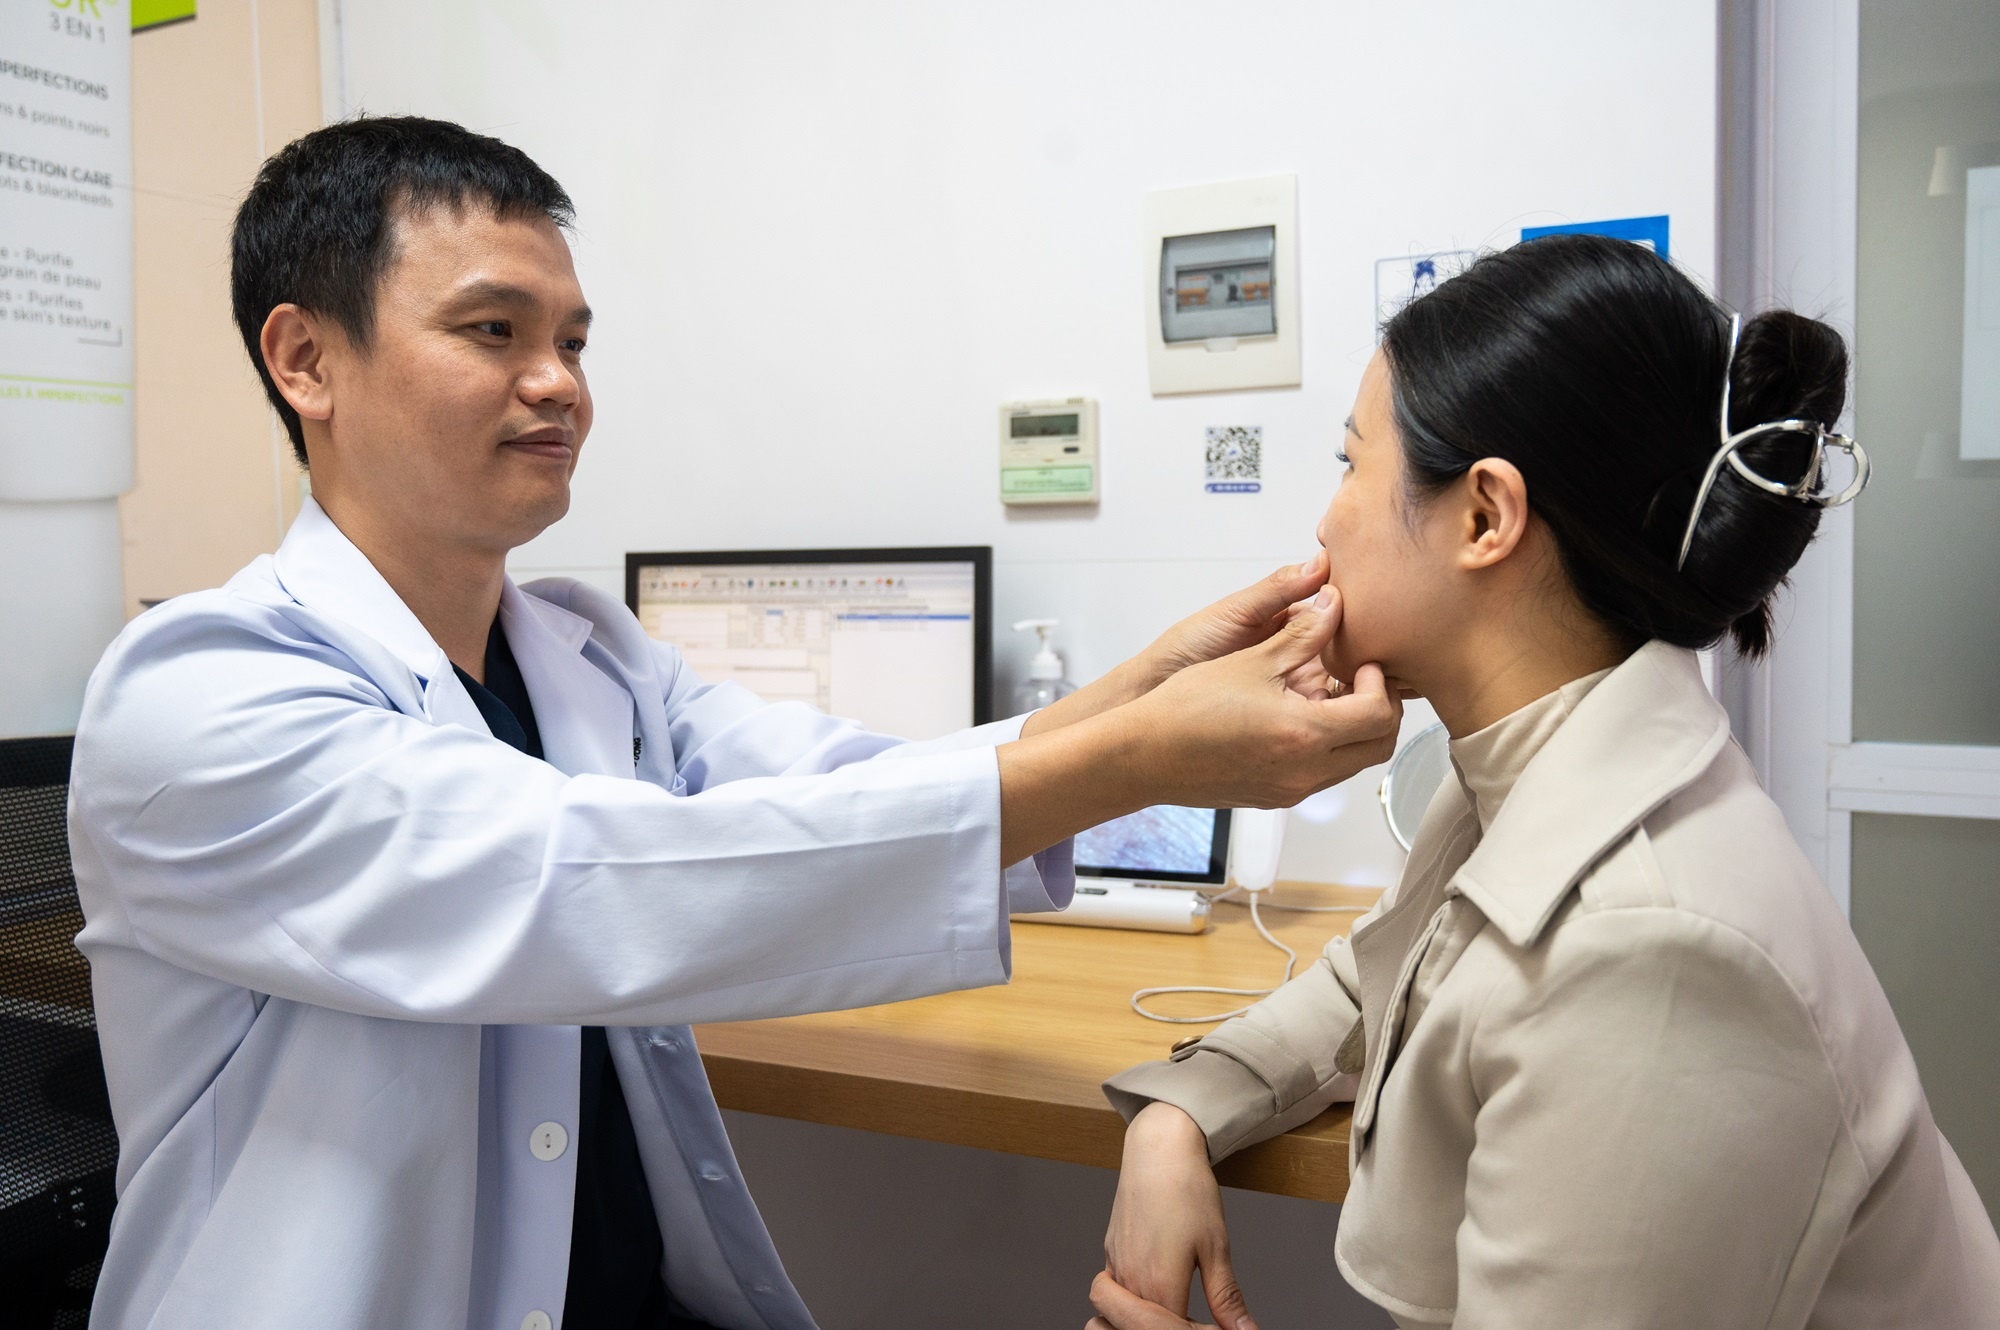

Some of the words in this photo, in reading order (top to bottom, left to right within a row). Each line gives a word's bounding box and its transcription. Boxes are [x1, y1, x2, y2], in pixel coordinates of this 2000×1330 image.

[49, 10, 60, 32] 3
[65, 16, 92, 40] EN
[98, 26, 105, 44] 1
[18, 105, 28, 120] &
[32, 109, 74, 131] points
[77, 119, 110, 139] noirs
[71, 166, 113, 188] CARE
[24, 178, 34, 193] &
[37, 180, 114, 209] blackheads
[25, 247, 73, 269] Purifie
[42, 268, 61, 286] de
[65, 272, 101, 291] peau
[28, 289, 84, 312] Purifies
[13, 307, 55, 326] skin's
[58, 311, 111, 332] texture
